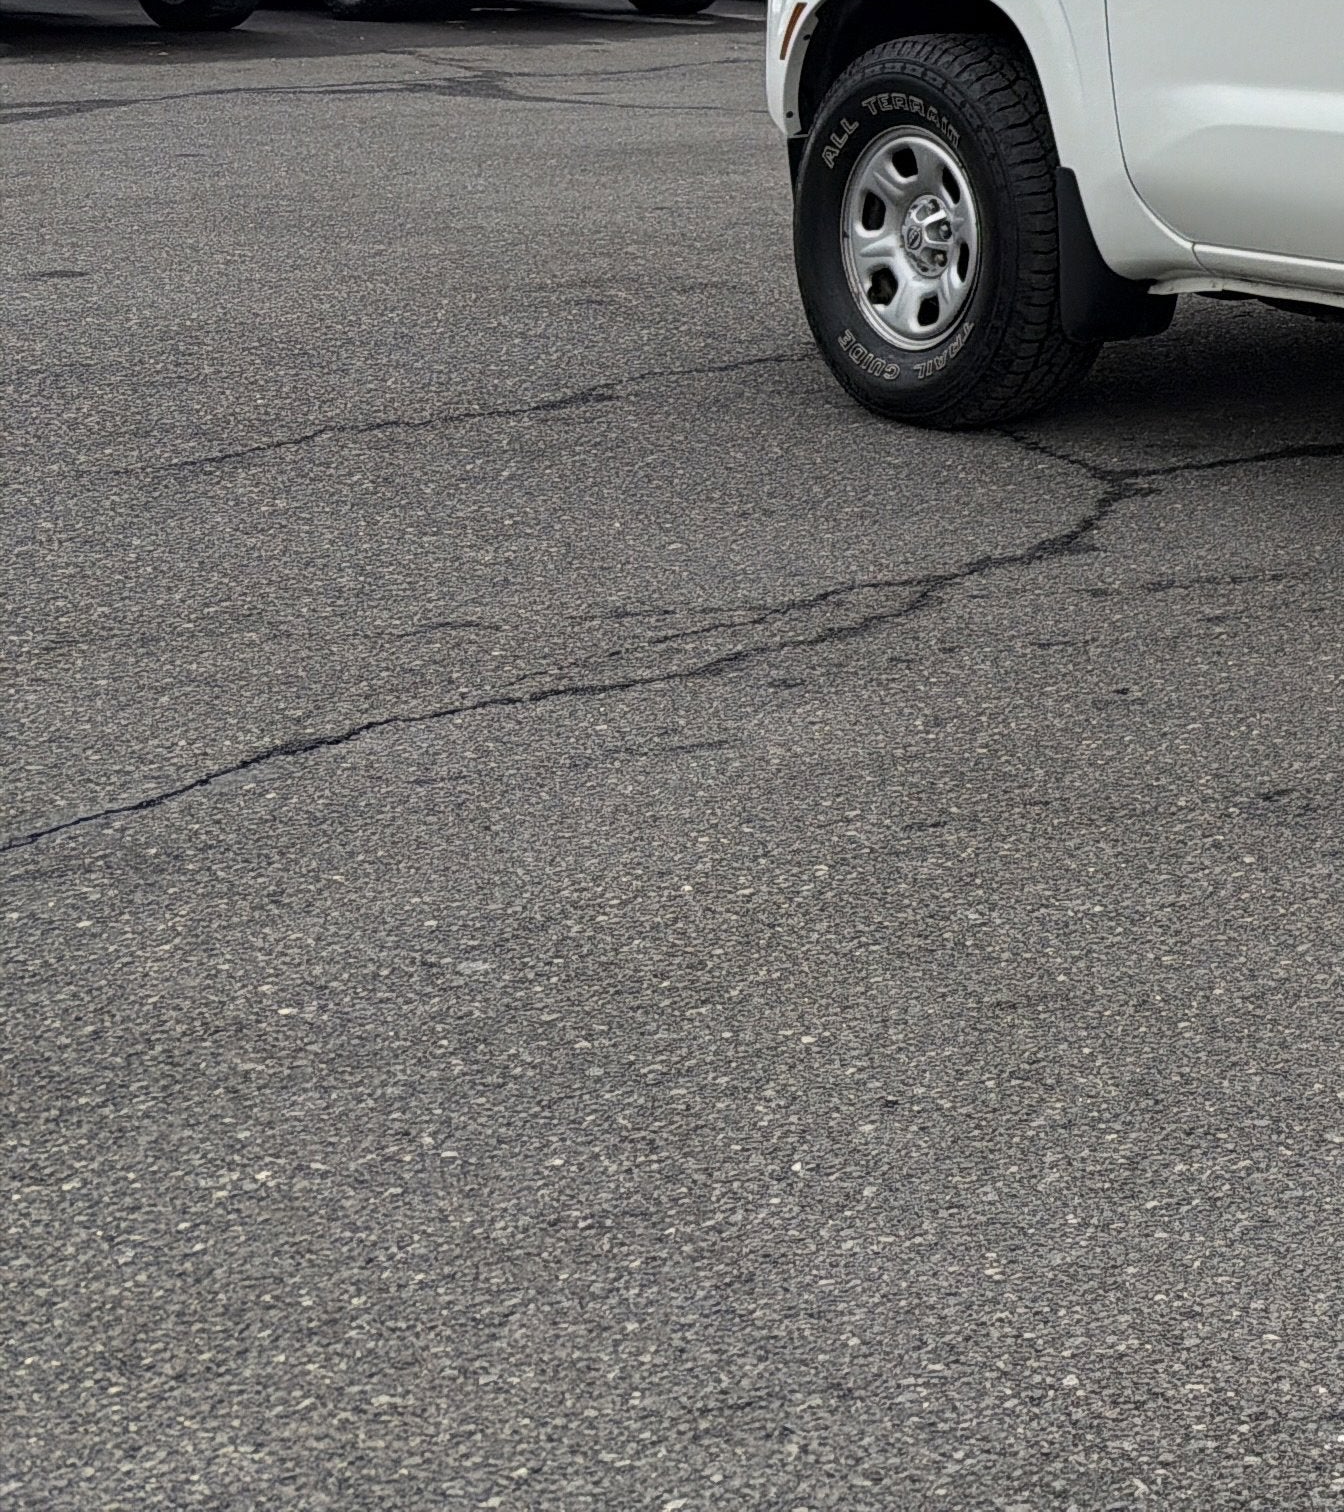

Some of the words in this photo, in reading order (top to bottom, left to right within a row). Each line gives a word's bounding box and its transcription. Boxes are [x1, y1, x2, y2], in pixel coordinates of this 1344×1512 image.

[822, 118, 860, 169] ALL
[861, 92, 961, 149] TERRAIN
[837, 328, 901, 380] GUIDE
[912, 321, 975, 379] TRAIL
